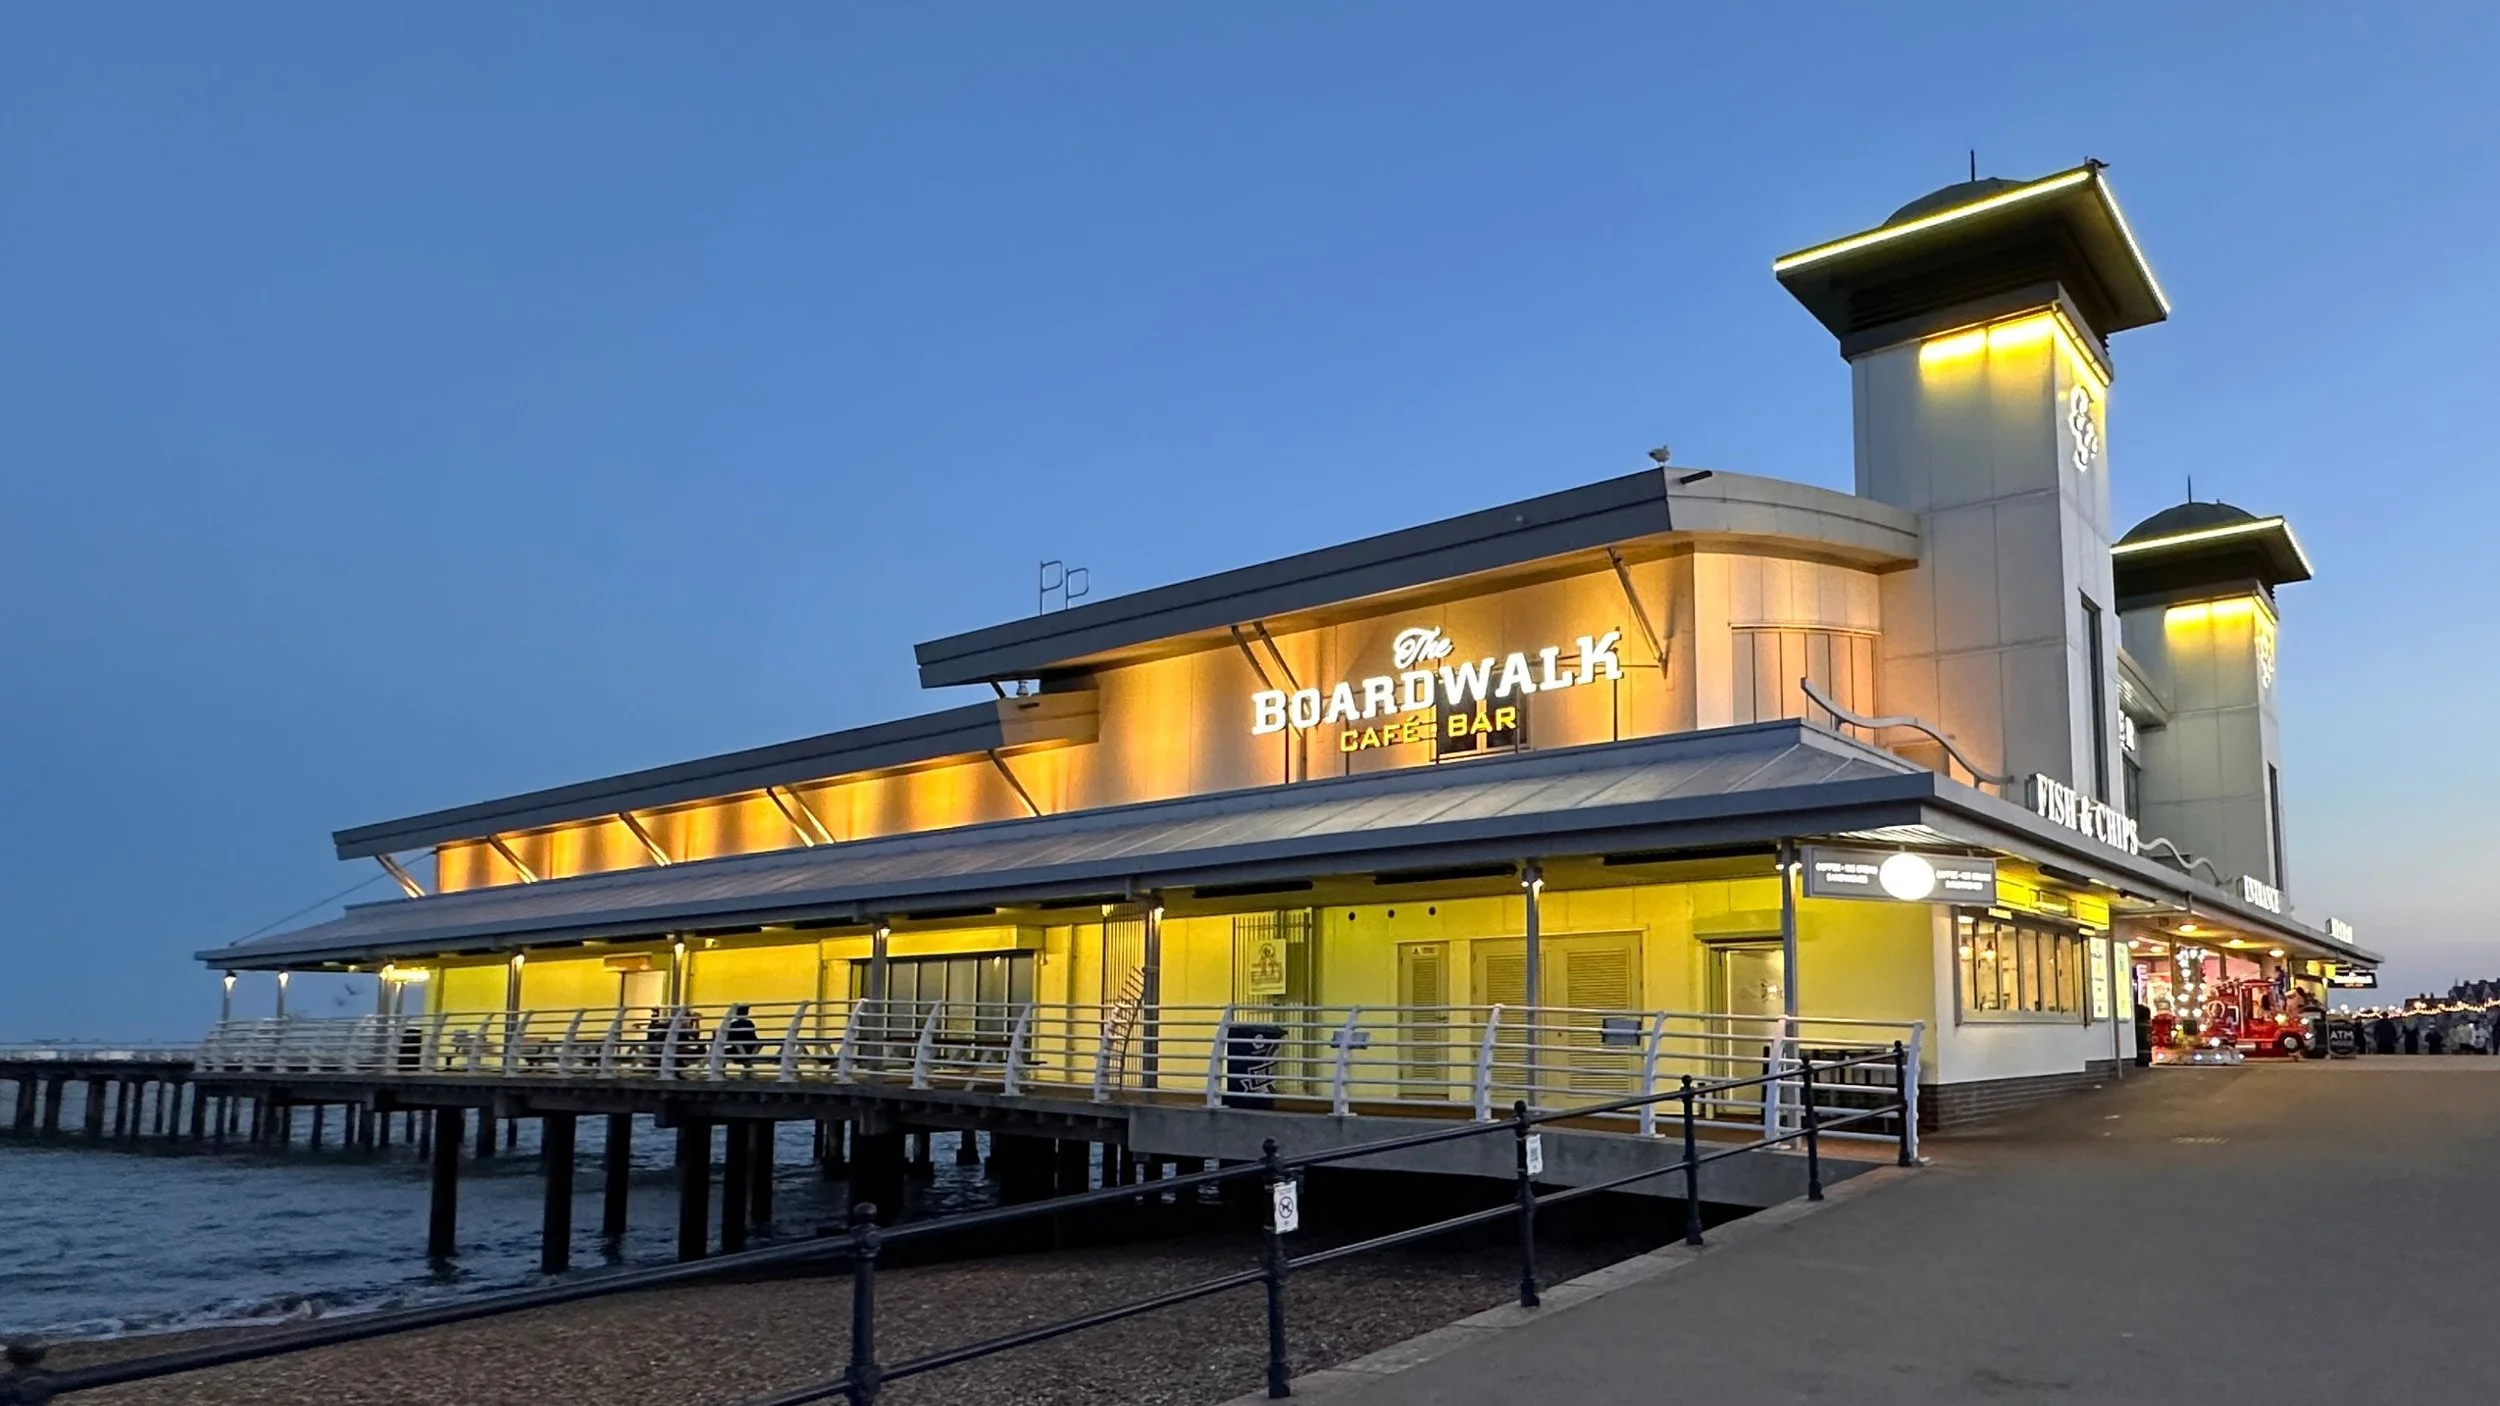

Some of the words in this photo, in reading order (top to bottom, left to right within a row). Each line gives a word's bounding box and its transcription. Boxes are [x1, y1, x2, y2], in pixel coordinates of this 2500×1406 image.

[1393, 626, 1453, 670] The
[1251, 631, 1624, 735] BOARDWALK
[1340, 715, 1420, 753] CAFÉ
[1448, 706, 1518, 738] BAR
[2035, 772, 2078, 831] FISH
[2080, 795, 2093, 838] &
[2094, 801, 2139, 856] CHIPS
[2330, 1030, 2354, 1040] ATM
